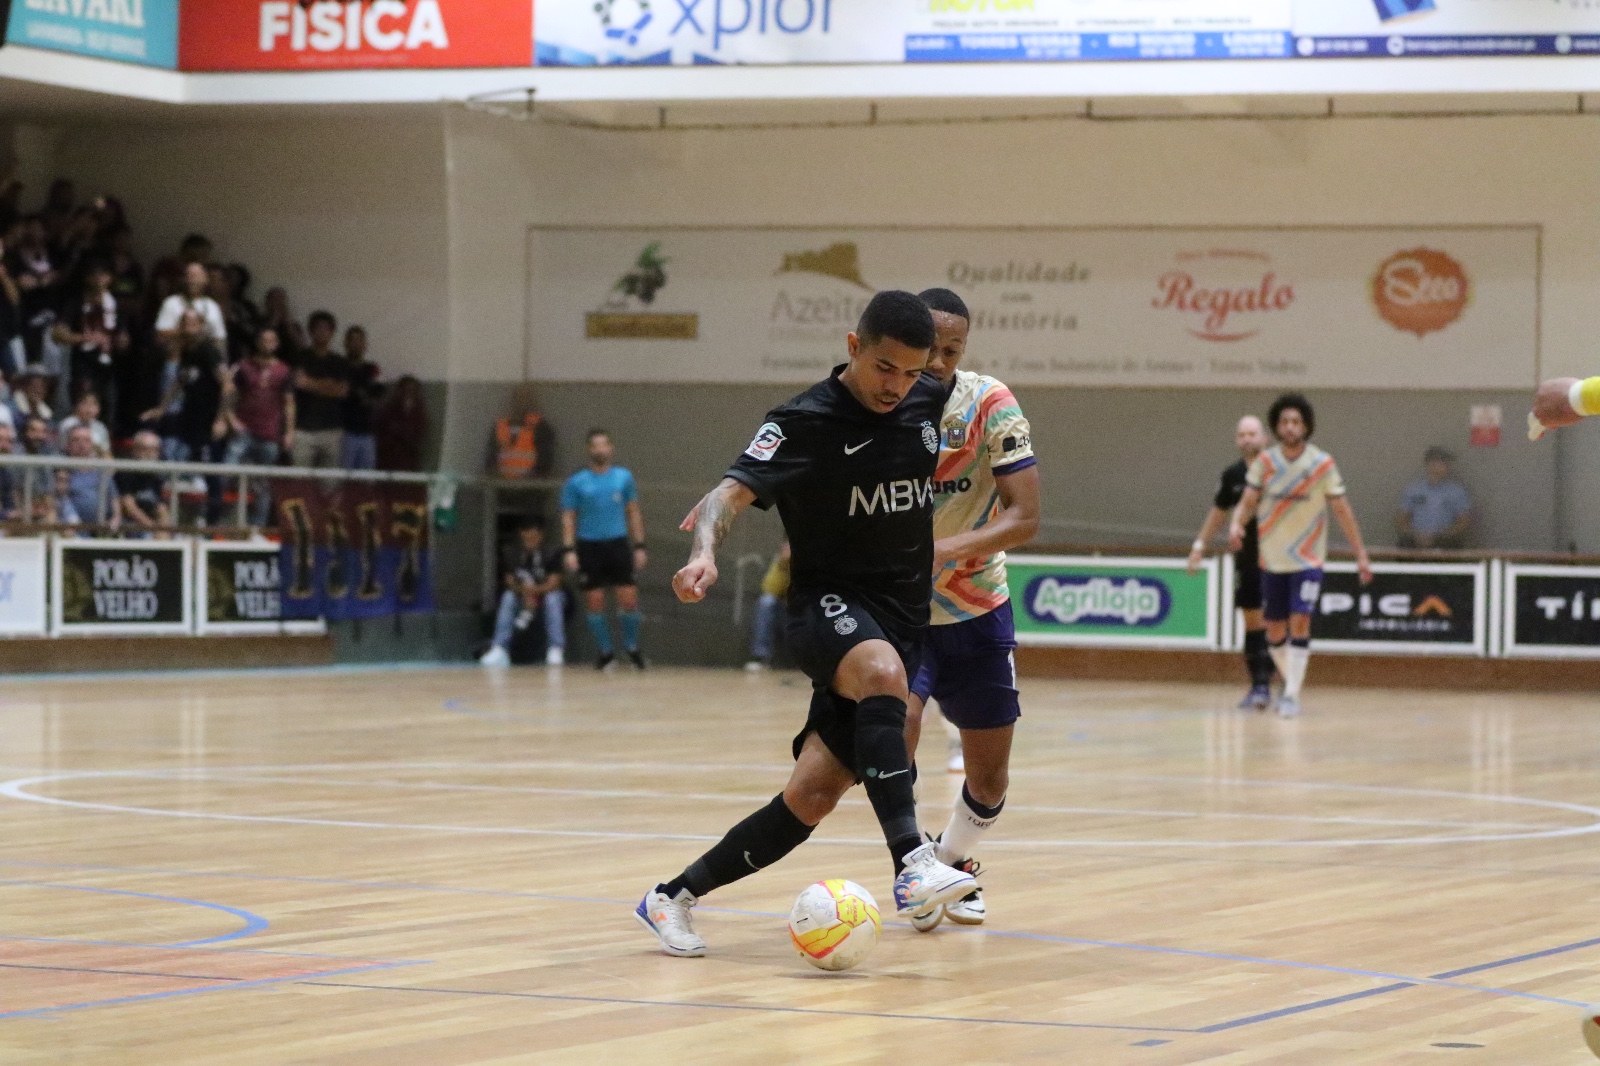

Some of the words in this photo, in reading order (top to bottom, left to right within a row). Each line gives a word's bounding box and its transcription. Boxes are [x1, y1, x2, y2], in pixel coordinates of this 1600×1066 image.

[947, 261, 1090, 289] Qualidade
[1151, 271, 1295, 332] Regalo
[92, 554, 159, 589] PORÃO
[93, 590, 159, 619] VELHO
[820, 594, 847, 617] 8
[1033, 577, 1161, 624] Agriloja
